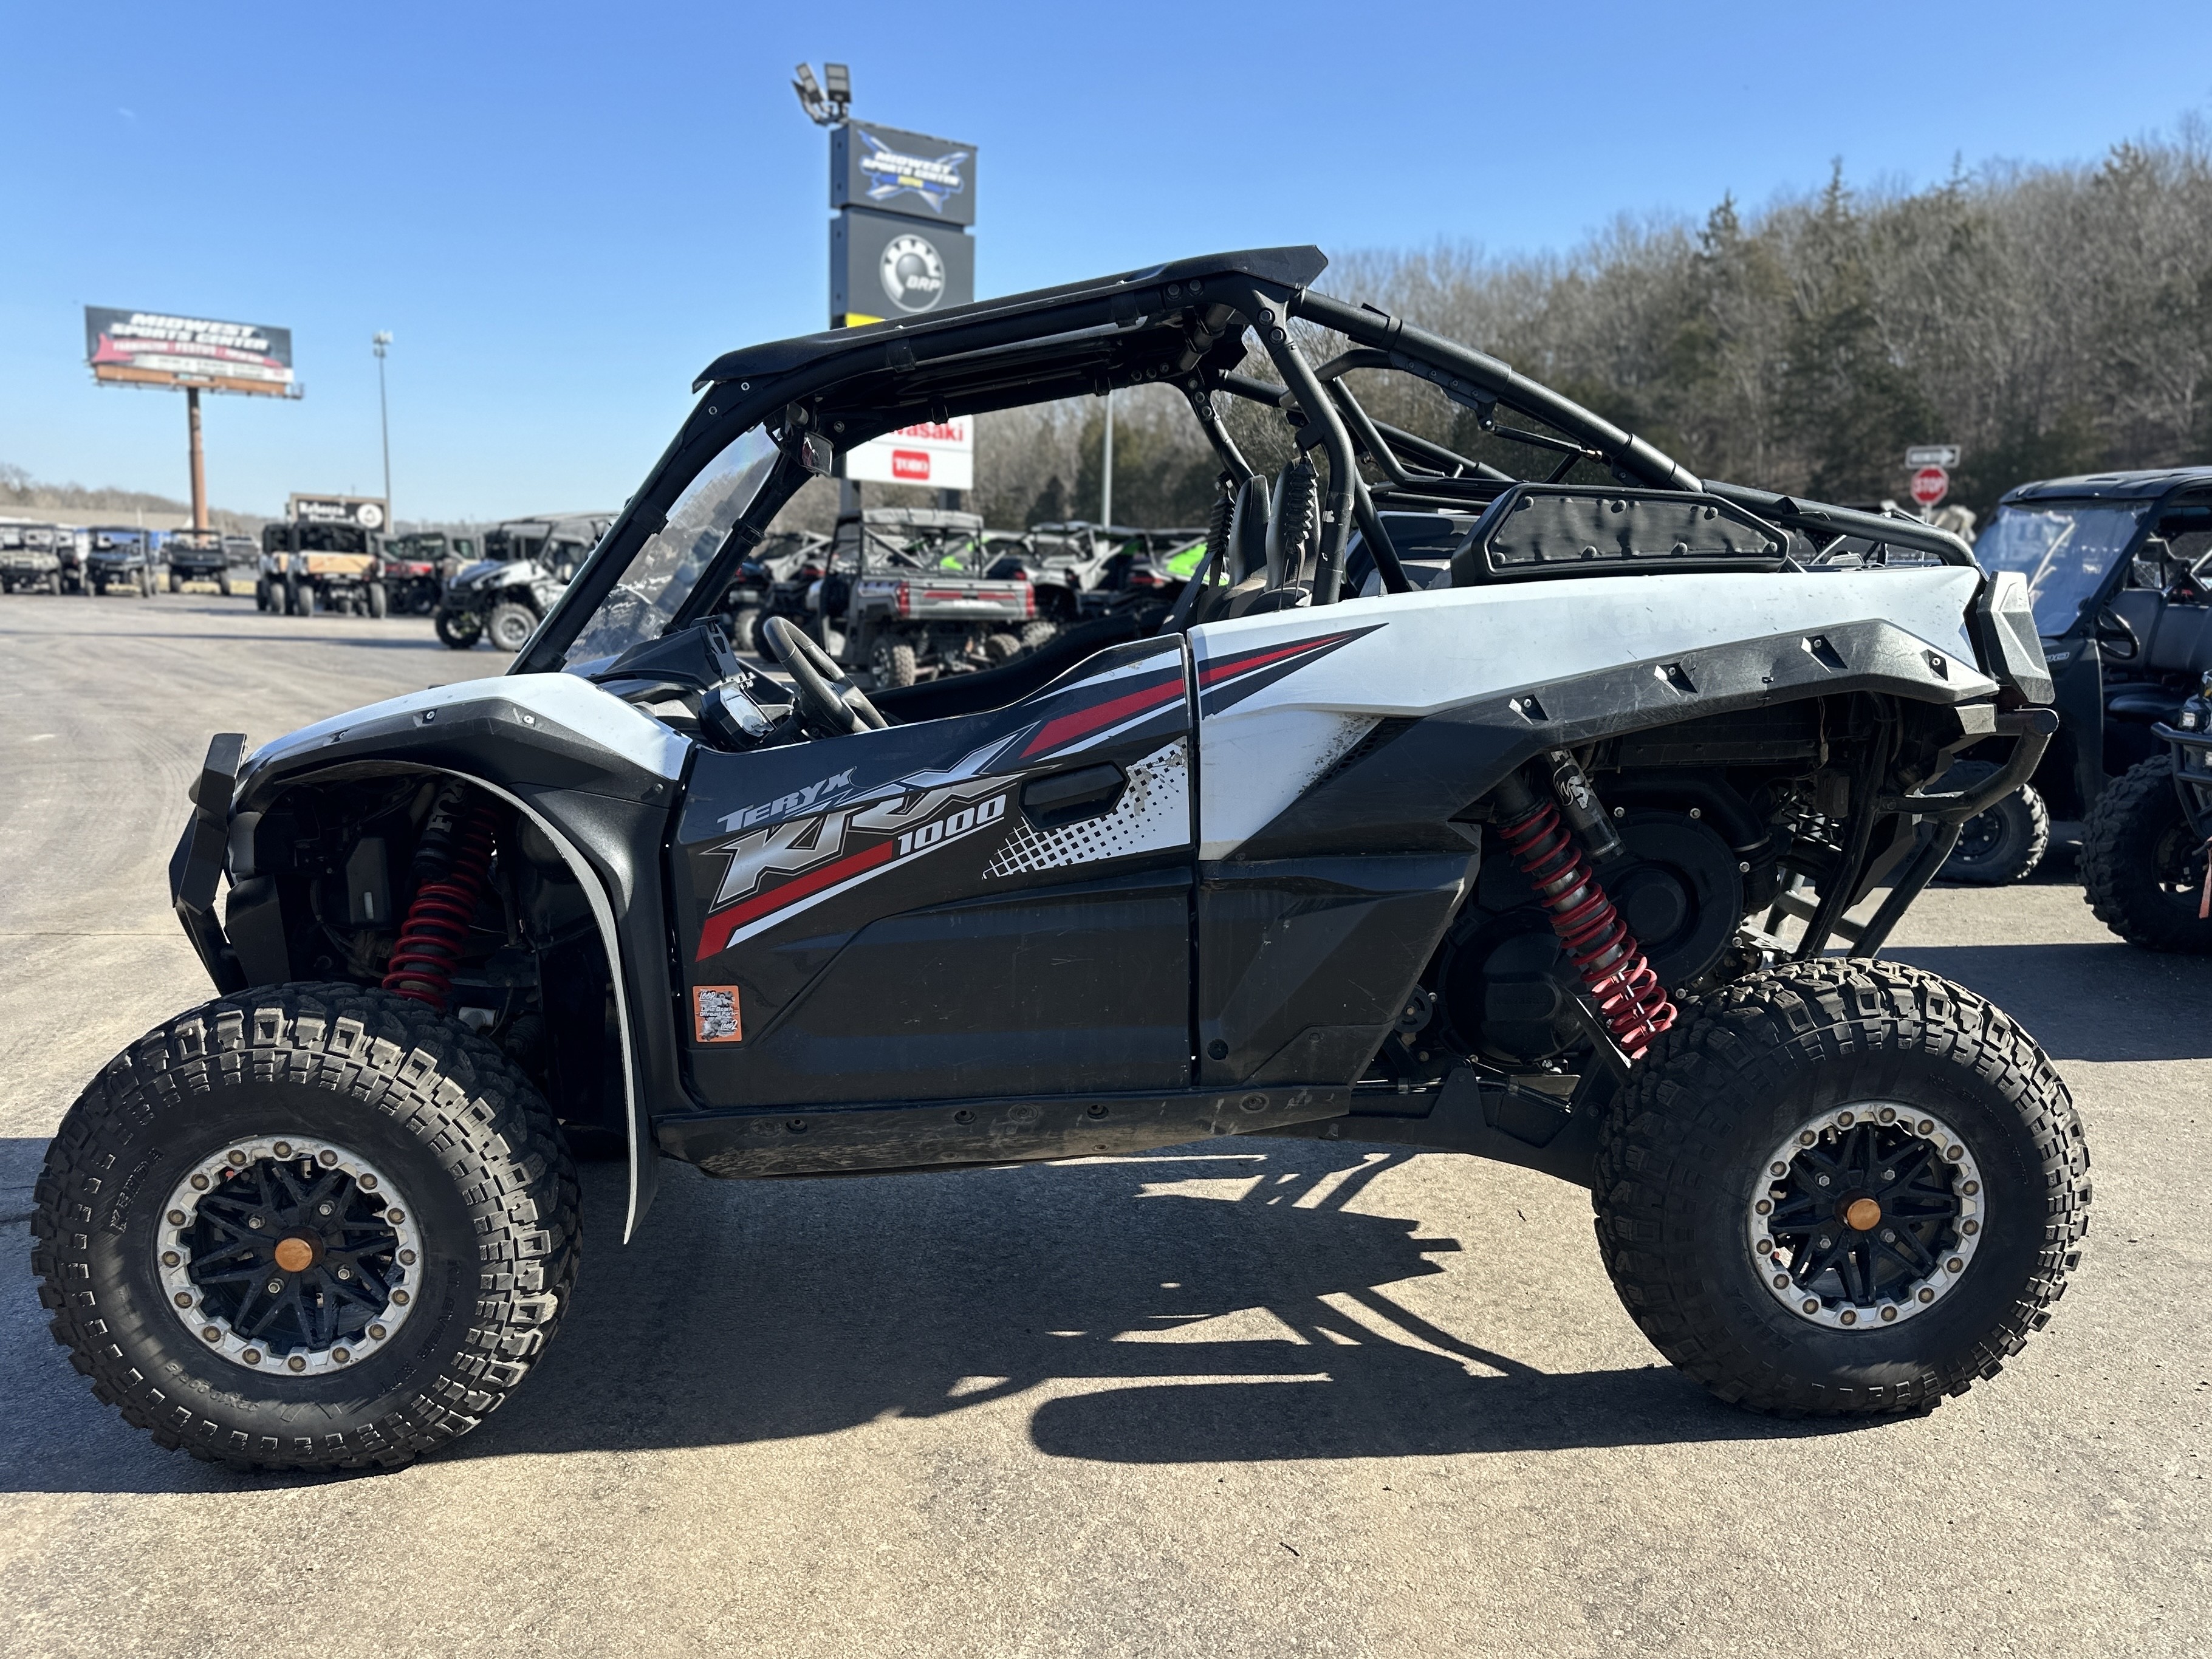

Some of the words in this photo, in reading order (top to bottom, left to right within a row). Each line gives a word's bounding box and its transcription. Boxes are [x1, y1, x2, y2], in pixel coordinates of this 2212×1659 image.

[863, 157, 912, 176] SPORTS
[914, 168, 959, 186] CENTER
[875, 151, 952, 174] MIDWEST
[906, 275, 941, 292] BRP
[109, 323, 193, 342] SPORTS
[195, 332, 270, 351] CENTER
[130, 313, 258, 338] MIDWEST
[894, 457, 929, 473] TORO
[1914, 477, 1944, 493] STOP
[425, 777, 467, 833] FOX
[706, 727, 1035, 909] KRX
[898, 793, 1007, 855] 1000
